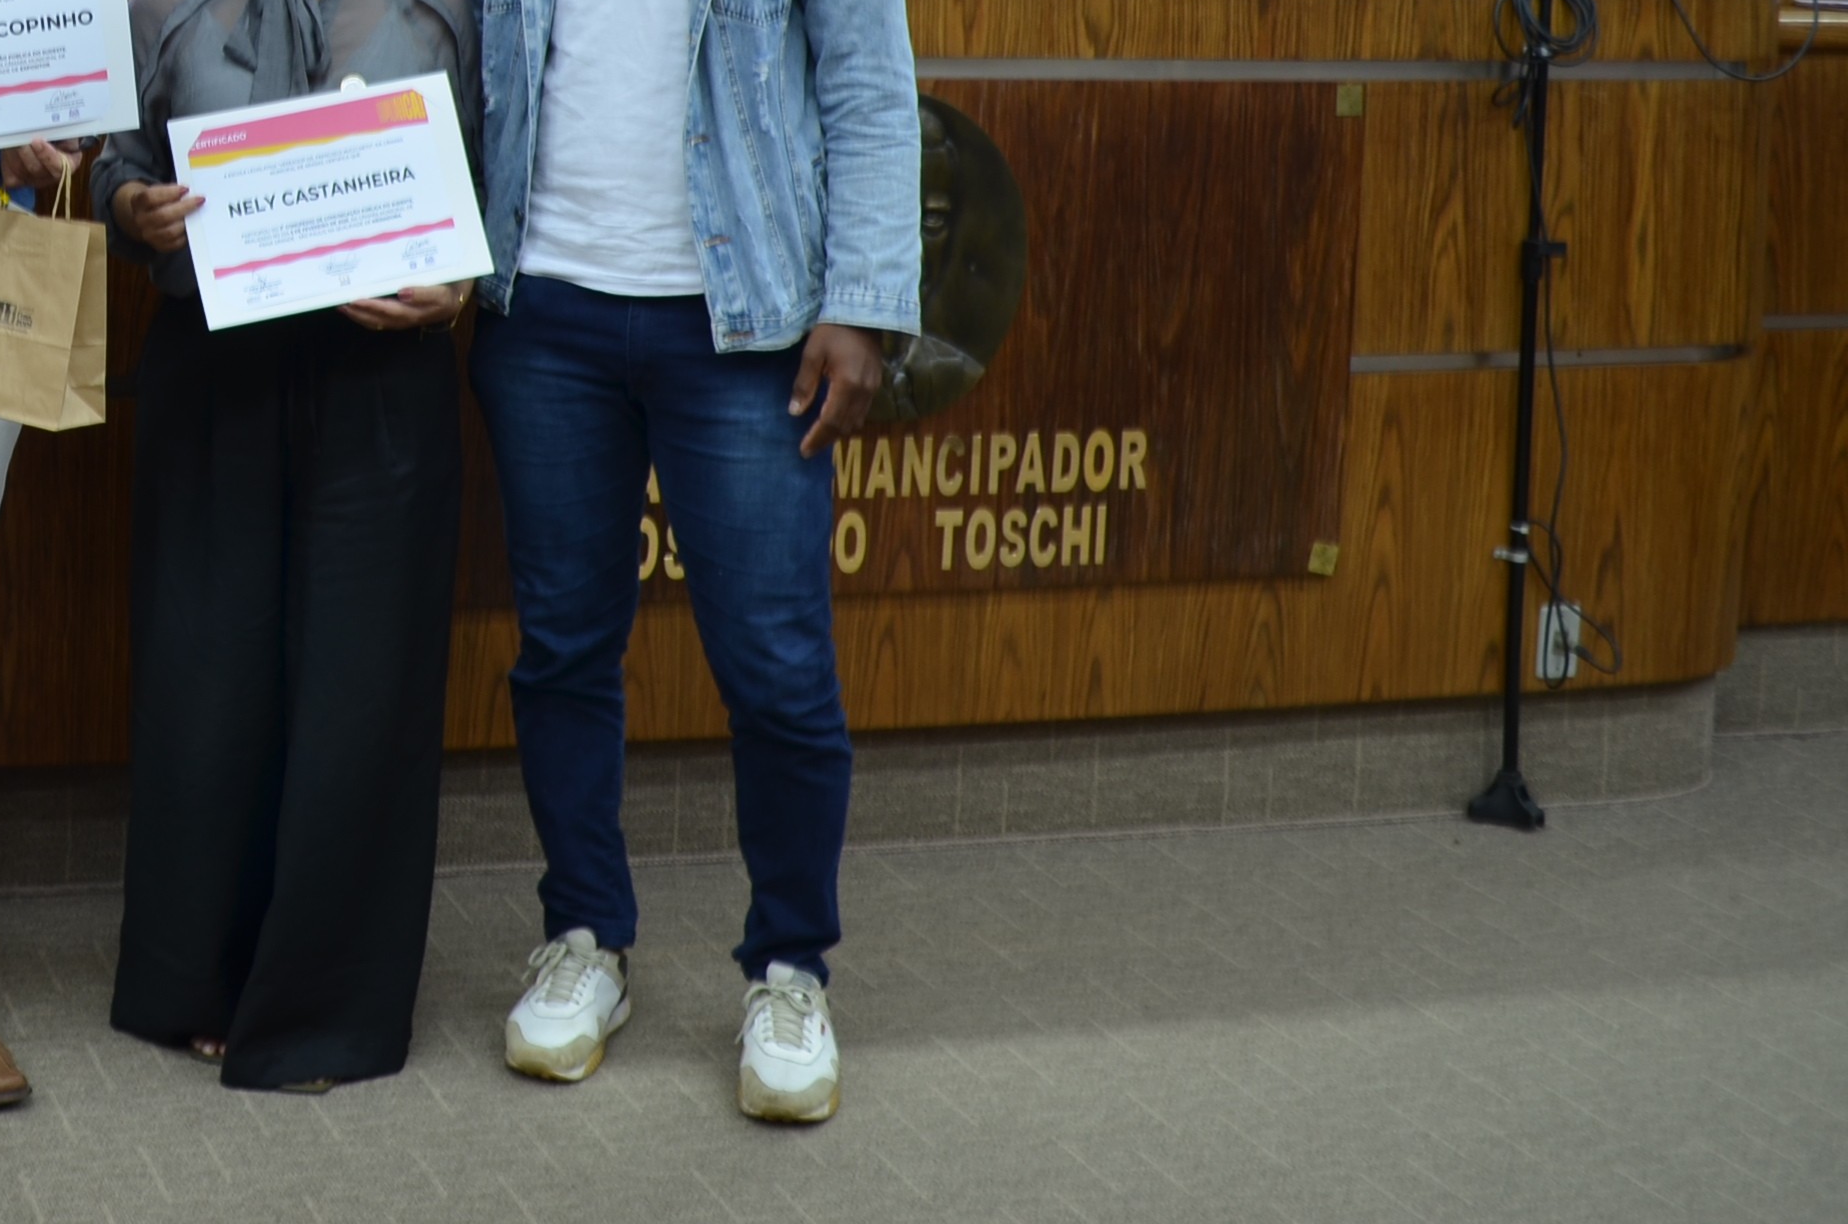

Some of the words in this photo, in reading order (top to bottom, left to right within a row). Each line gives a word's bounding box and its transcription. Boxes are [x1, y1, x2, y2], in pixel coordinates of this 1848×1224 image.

[228, 193, 277, 218] NELY
[282, 166, 415, 206] CASTANHEIRA
[935, 504, 1107, 570] TOSCHI
